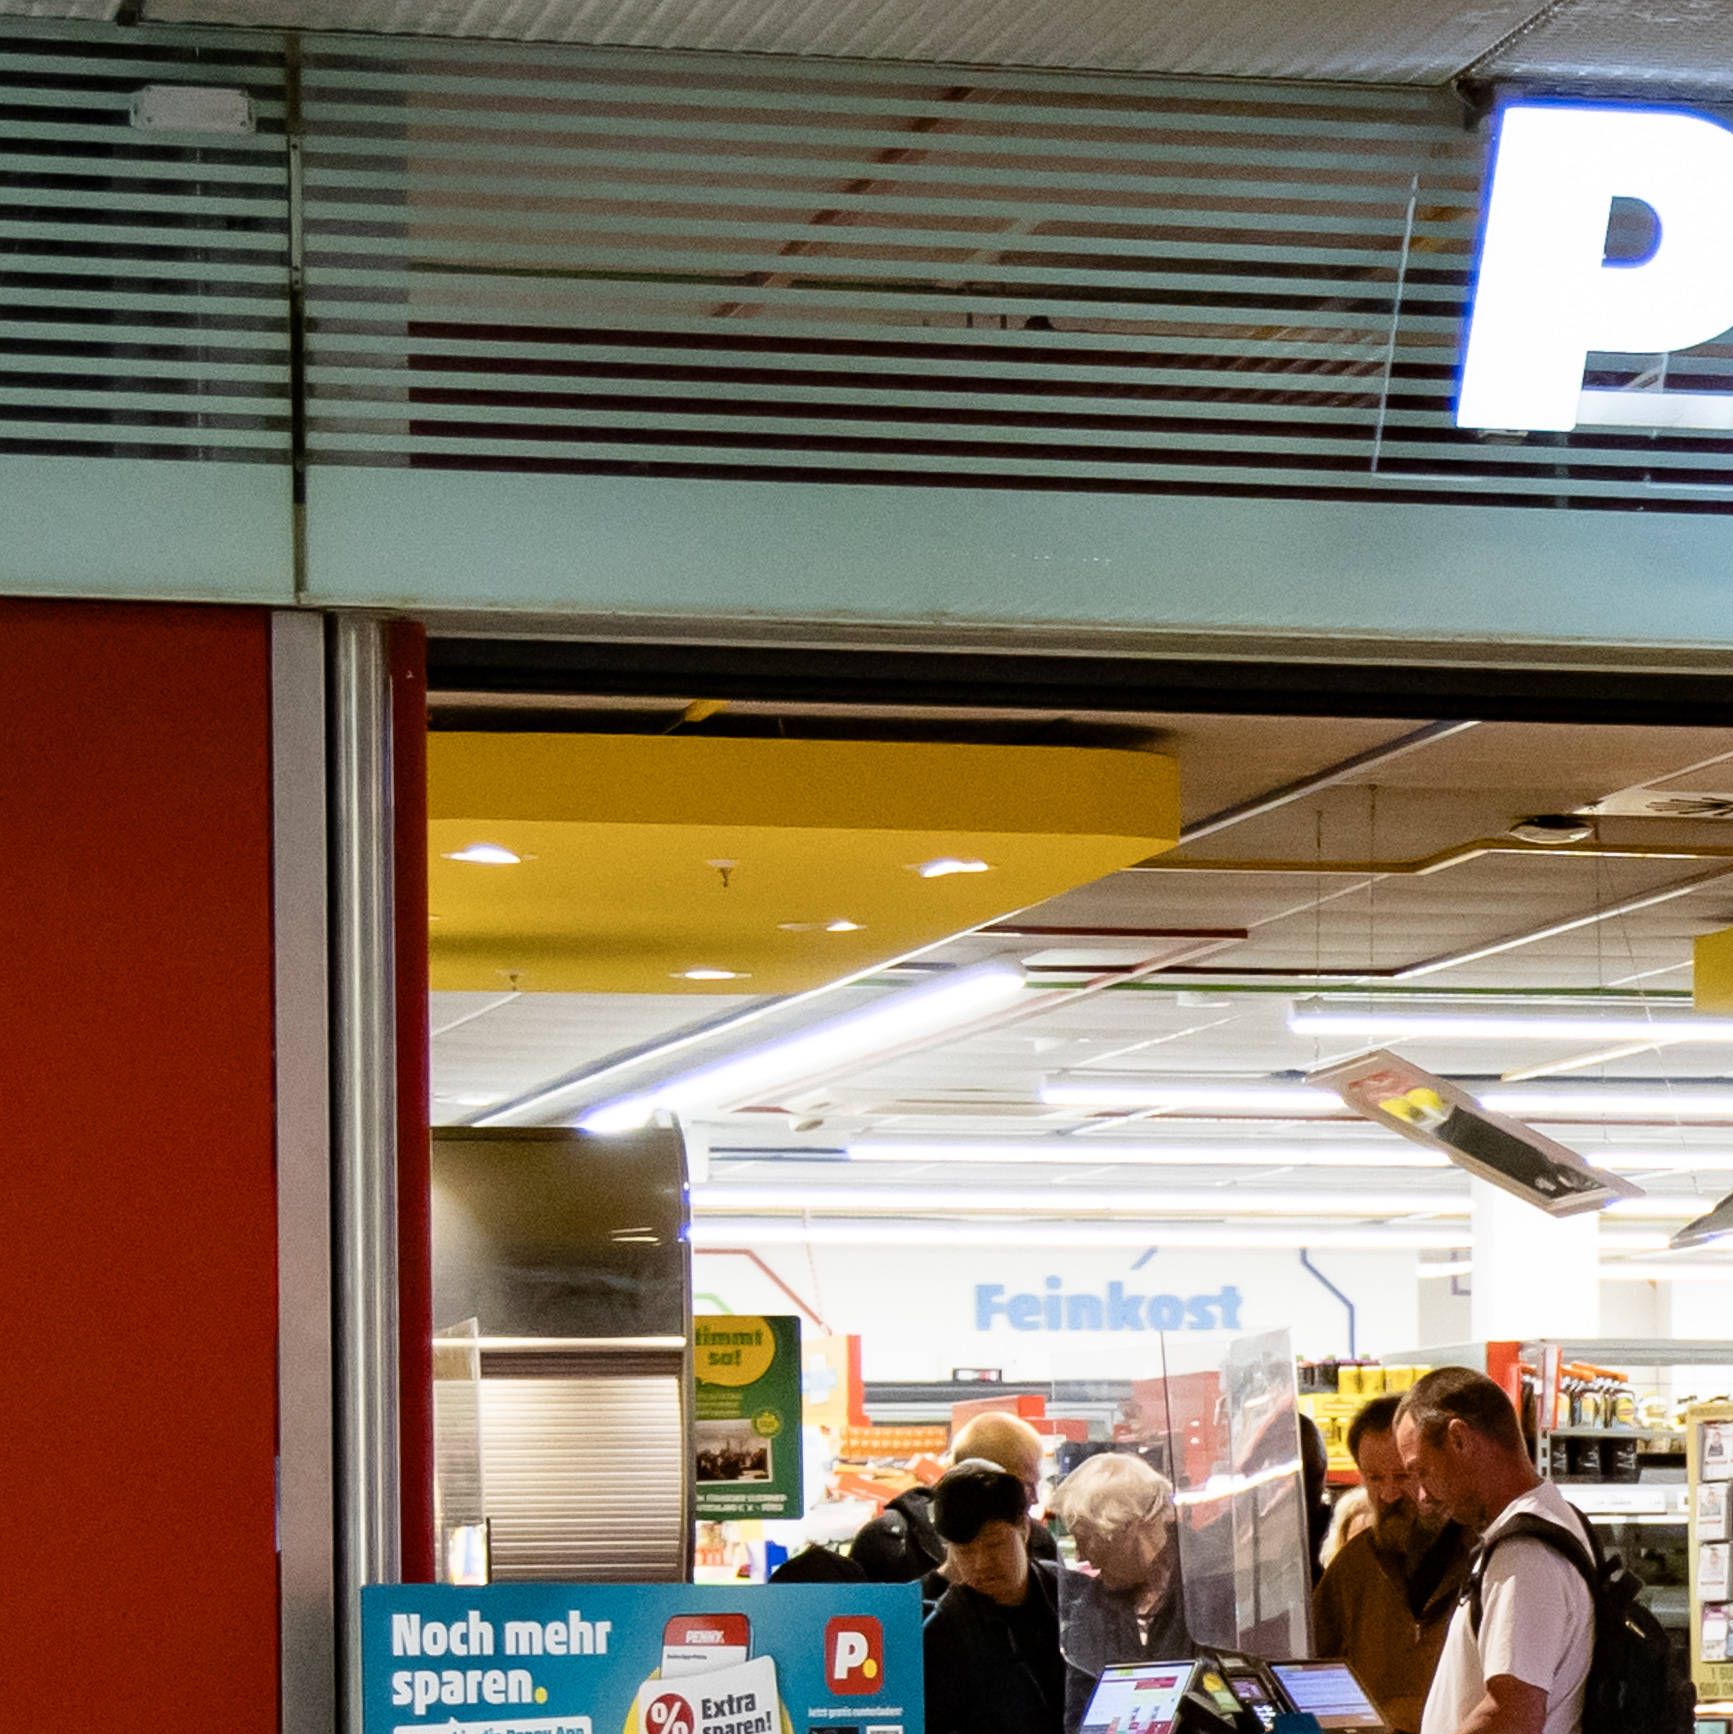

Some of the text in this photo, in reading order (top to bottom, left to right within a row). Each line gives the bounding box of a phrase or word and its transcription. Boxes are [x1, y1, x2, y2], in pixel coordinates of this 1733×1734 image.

[973, 1276, 1244, 1332] Feinkost
[391, 1610, 612, 1656] Noch mehr
[391, 1668, 548, 1715] sparen.
[701, 1692, 756, 1721] Extra
